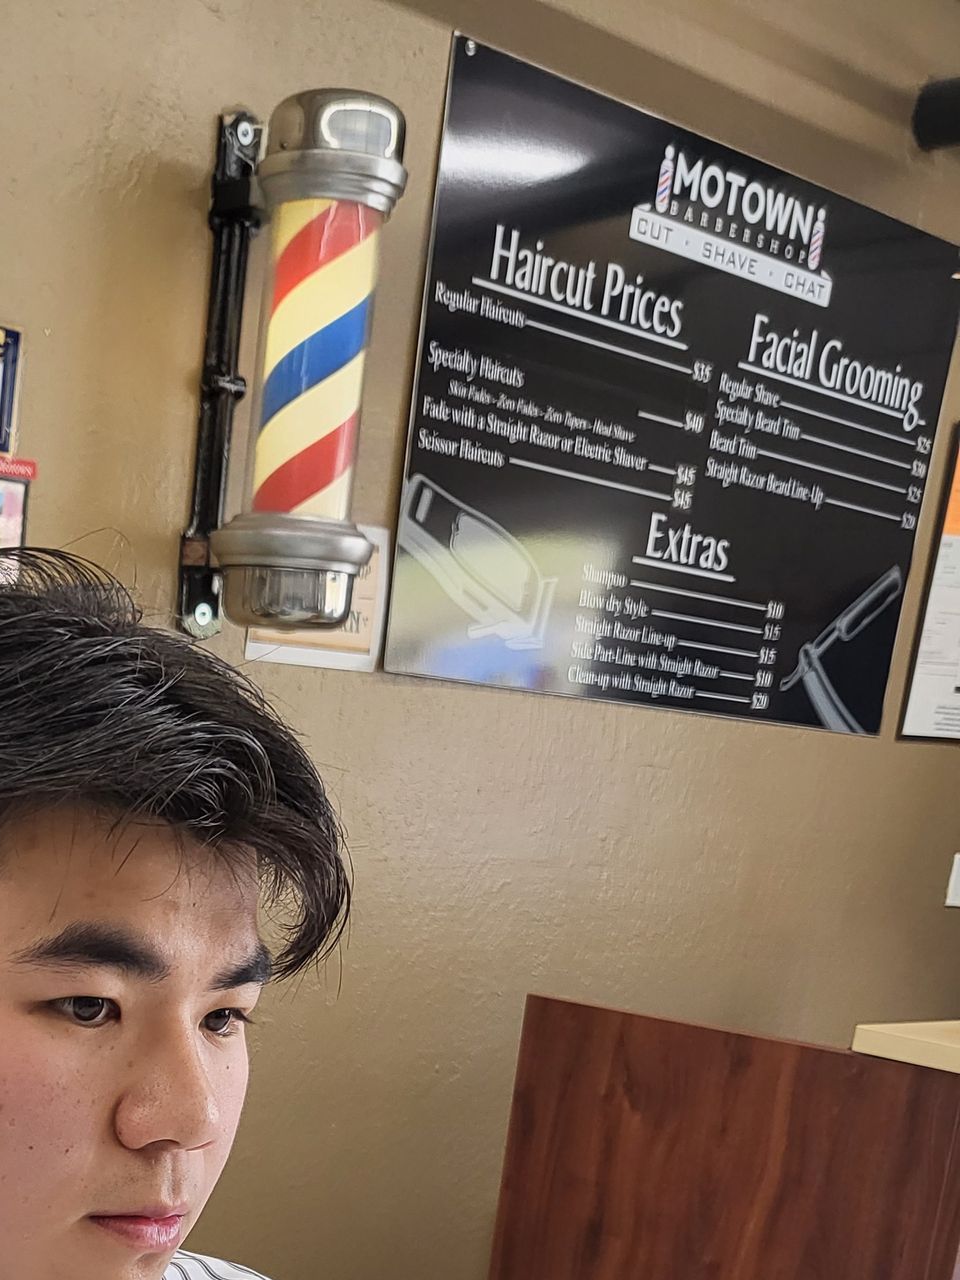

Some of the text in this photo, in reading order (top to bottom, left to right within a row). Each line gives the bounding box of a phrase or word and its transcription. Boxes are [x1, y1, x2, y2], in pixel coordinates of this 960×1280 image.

[673, 152, 814, 244] MOTOWN
[669, 200, 807, 264] BARBERSHOP
[636, 217, 825, 299] CUT SHAVE CHAT
[490, 224, 684, 338] Haircut Prices
[435, 280, 480, 312] Regular
[480, 295, 526, 328] Haircuts
[428, 340, 525, 388] Specialty Haircuts
[747, 313, 925, 432] Facial Grooming
[719, 372, 754, 402] Regular
[754, 383, 780, 408] Shave
[423, 395, 451, 421] Fade
[452, 405, 476, 428] with
[477, 415, 486, 430] a
[486, 412, 529, 444] Straight
[529, 424, 561, 449] Razor
[561, 437, 574, 452] or
[574, 435, 613, 463] Electric
[613, 445, 648, 471] Shaver
[715, 398, 754, 433] Specialty
[754, 409, 781, 435] Beard
[781, 418, 800, 440] Trim
[418, 427, 459, 456] Scissor
[459, 438, 506, 468] Haircuts
[710, 429, 738, 455] Beard
[738, 437, 757, 459] Trim
[705, 456, 739, 488] Straight
[739, 465, 767, 489] Razor
[766, 472, 791, 496] Beard
[645, 511, 730, 572] Extras
[583, 563, 628, 590] Shampoo
[579, 589, 605, 609] Blow
[623, 595, 649, 620] Style
[574, 615, 613, 640] Straight
[612, 620, 641, 642] Razor
[571, 640, 593, 660] Side
[638, 650, 657, 669] with
[658, 652, 693, 677] Straight
[693, 658, 720, 679] Razor
[568, 664, 610, 690] Clean-up
[611, 671, 632, 690] with
[633, 674, 668, 698] Straight
[668, 678, 696, 699] Razor
